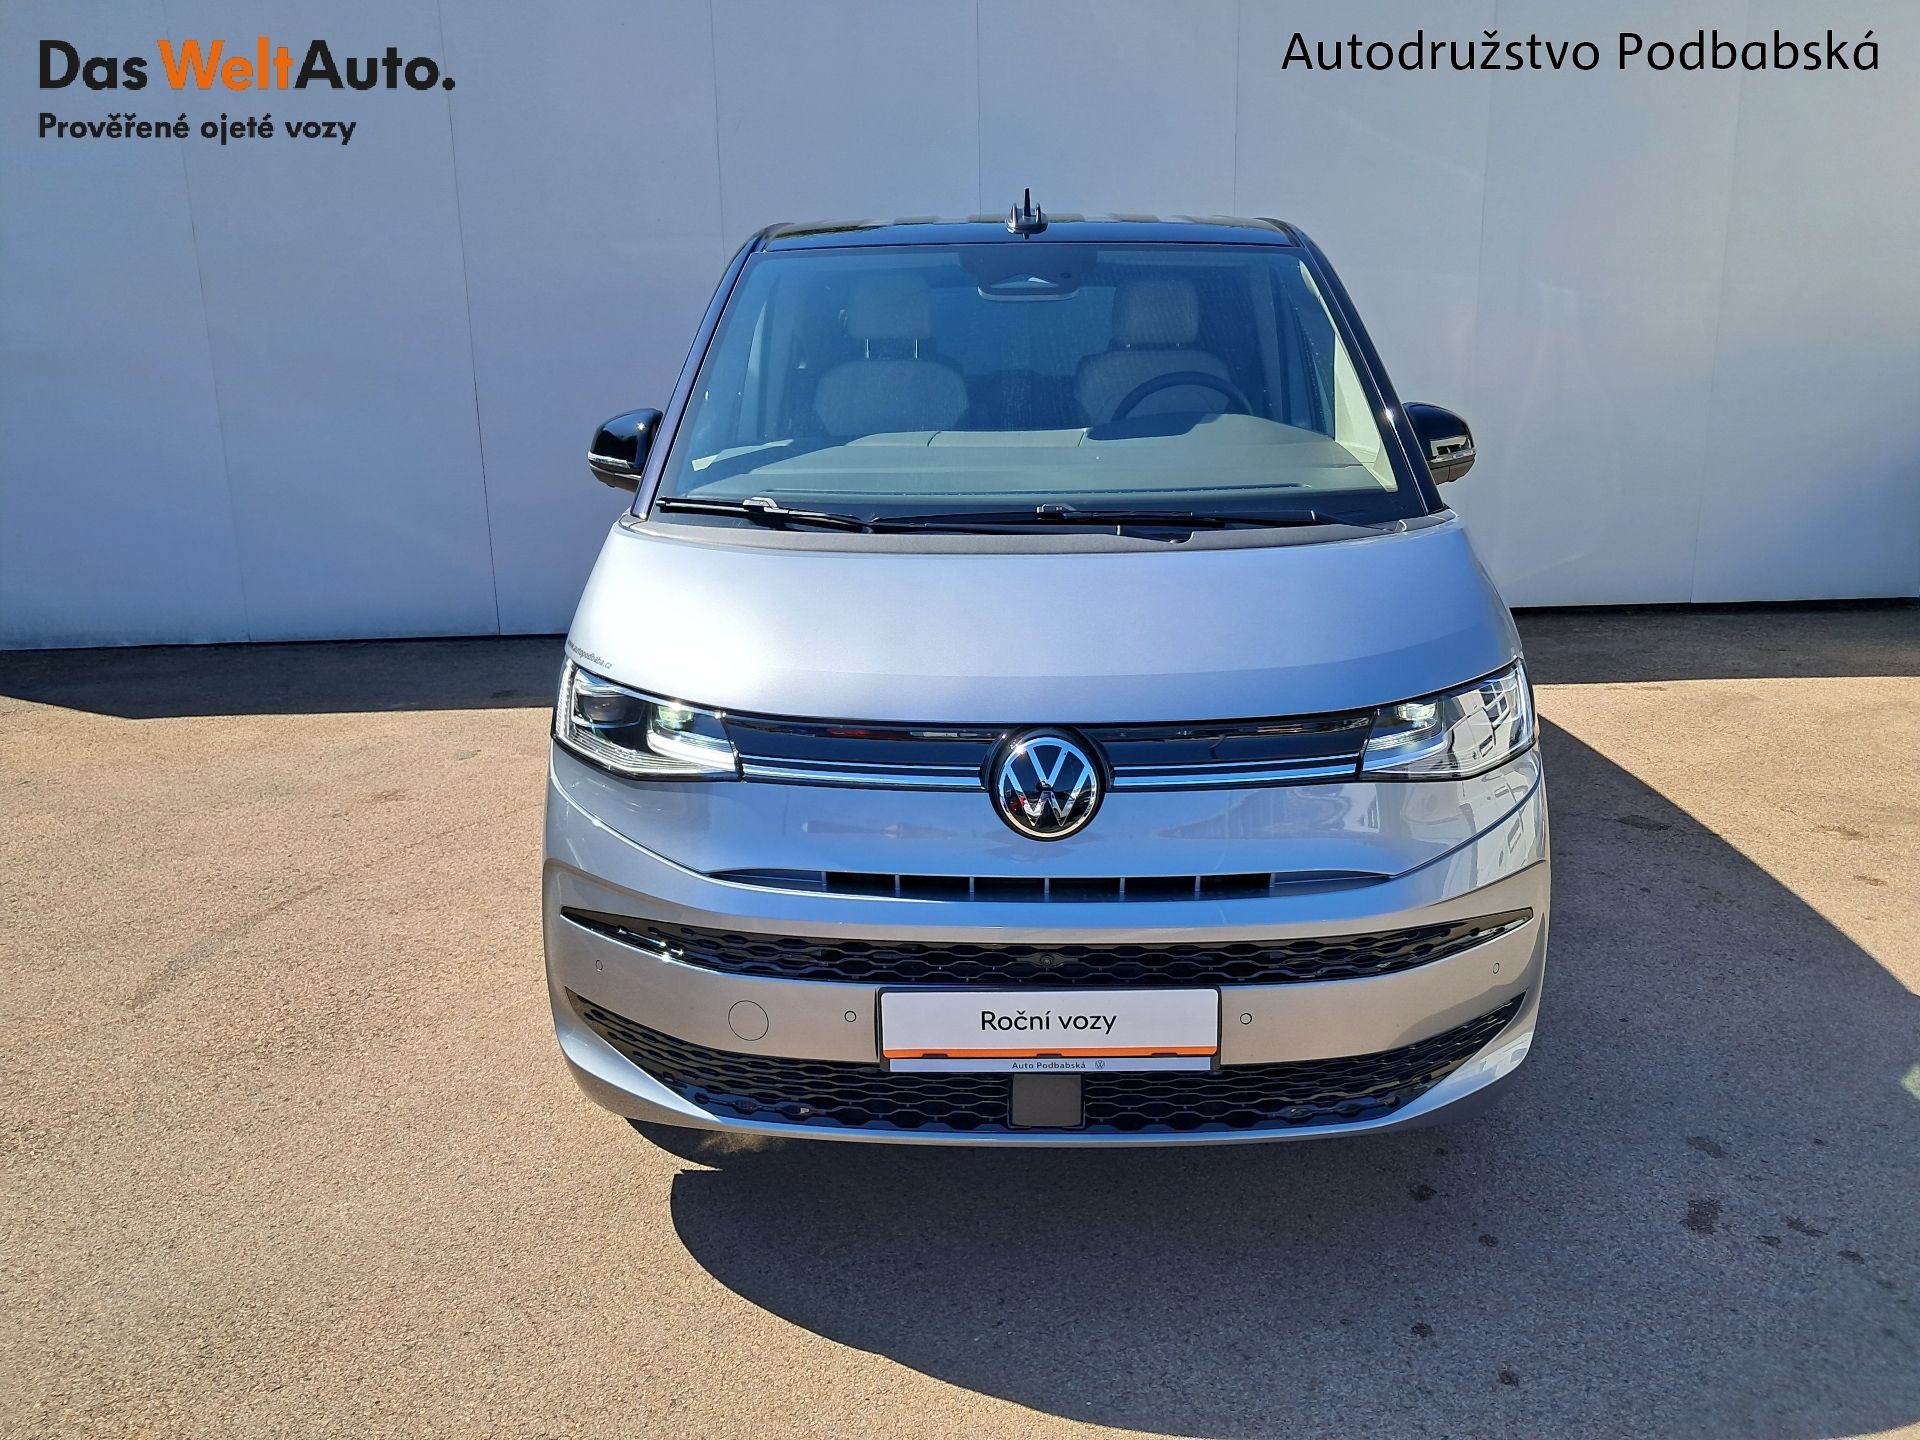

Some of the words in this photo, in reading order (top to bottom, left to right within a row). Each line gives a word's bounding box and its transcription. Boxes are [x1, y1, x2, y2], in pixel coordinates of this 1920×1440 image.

[981, 1010, 1051, 1031] Roční
[1058, 1015, 1117, 1035] vozy
[1012, 1061, 1034, 1069] Auto
[1036, 1060, 1086, 1069] Podbabská
